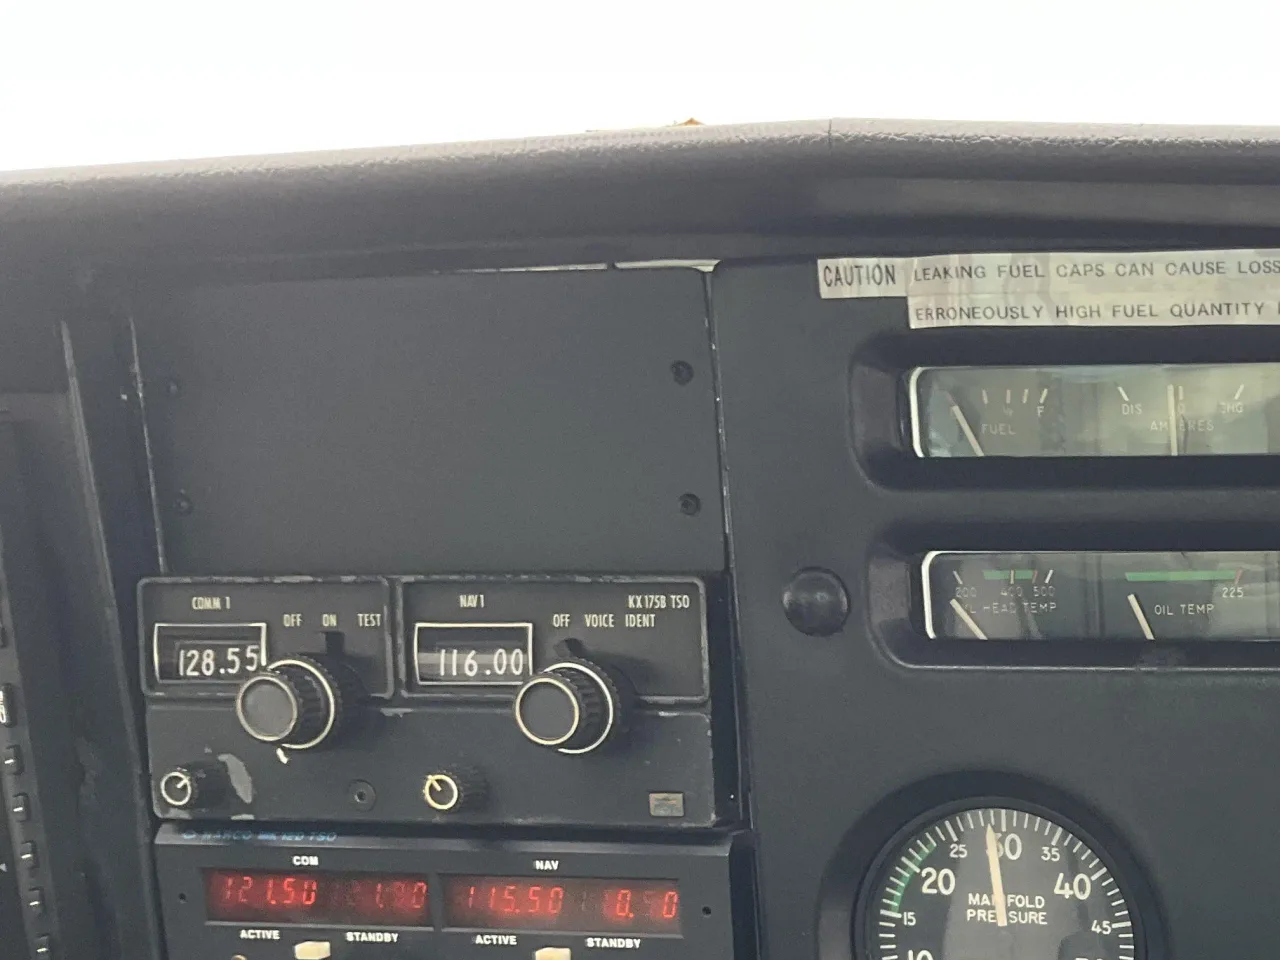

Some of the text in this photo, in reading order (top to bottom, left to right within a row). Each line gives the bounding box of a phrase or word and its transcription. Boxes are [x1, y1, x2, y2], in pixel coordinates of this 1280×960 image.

[823, 264, 897, 288] CAUTION
[914, 266, 987, 282] LEAKING
[997, 264, 1045, 279] FUEL
[1056, 263, 1105, 278] CAPS
[1115, 262, 1154, 277] CAN
[1165, 261, 1225, 276] CAUSE
[916, 305, 1044, 321] ERRONEOUSLY
[1056, 305, 1101, 319] HIGH
[1112, 304, 1158, 319] FUEL
[1170, 302, 1264, 318] QUANTITY
[1122, 403, 1143, 415] DIS
[981, 423, 1016, 436] FUEL
[1033, 586, 1055, 597] 500
[1222, 587, 1244, 598] 225
[459, 594, 477, 608] NAV
[671, 594, 690, 609] TSO
[1023, 602, 1056, 613] TEMP
[1154, 604, 1214, 616] OIL TEMP
[283, 613, 381, 627] OFF ON TEST
[553, 614, 656, 628] OFF VOICE IDENT
[179, 645, 259, 676] 128.55
[440, 648, 523, 676] 116.00
[949, 843, 968, 859] 25
[1041, 847, 1060, 862] 35
[293, 856, 318, 866] COM
[535, 860, 559, 871] NAV
[921, 867, 956, 895] 20
[1053, 873, 1091, 900] 40
[968, 893, 1045, 908] MAFOLD
[903, 912, 916, 926] 15
[967, 909, 1047, 925] PRESURE
[1091, 920, 1112, 935] 45
[239, 930, 280, 940] ACTIVE
[345, 932, 398, 943] STANDBY
[475, 935, 517, 945] ACTIVE
[586, 938, 641, 949] STANDBY
